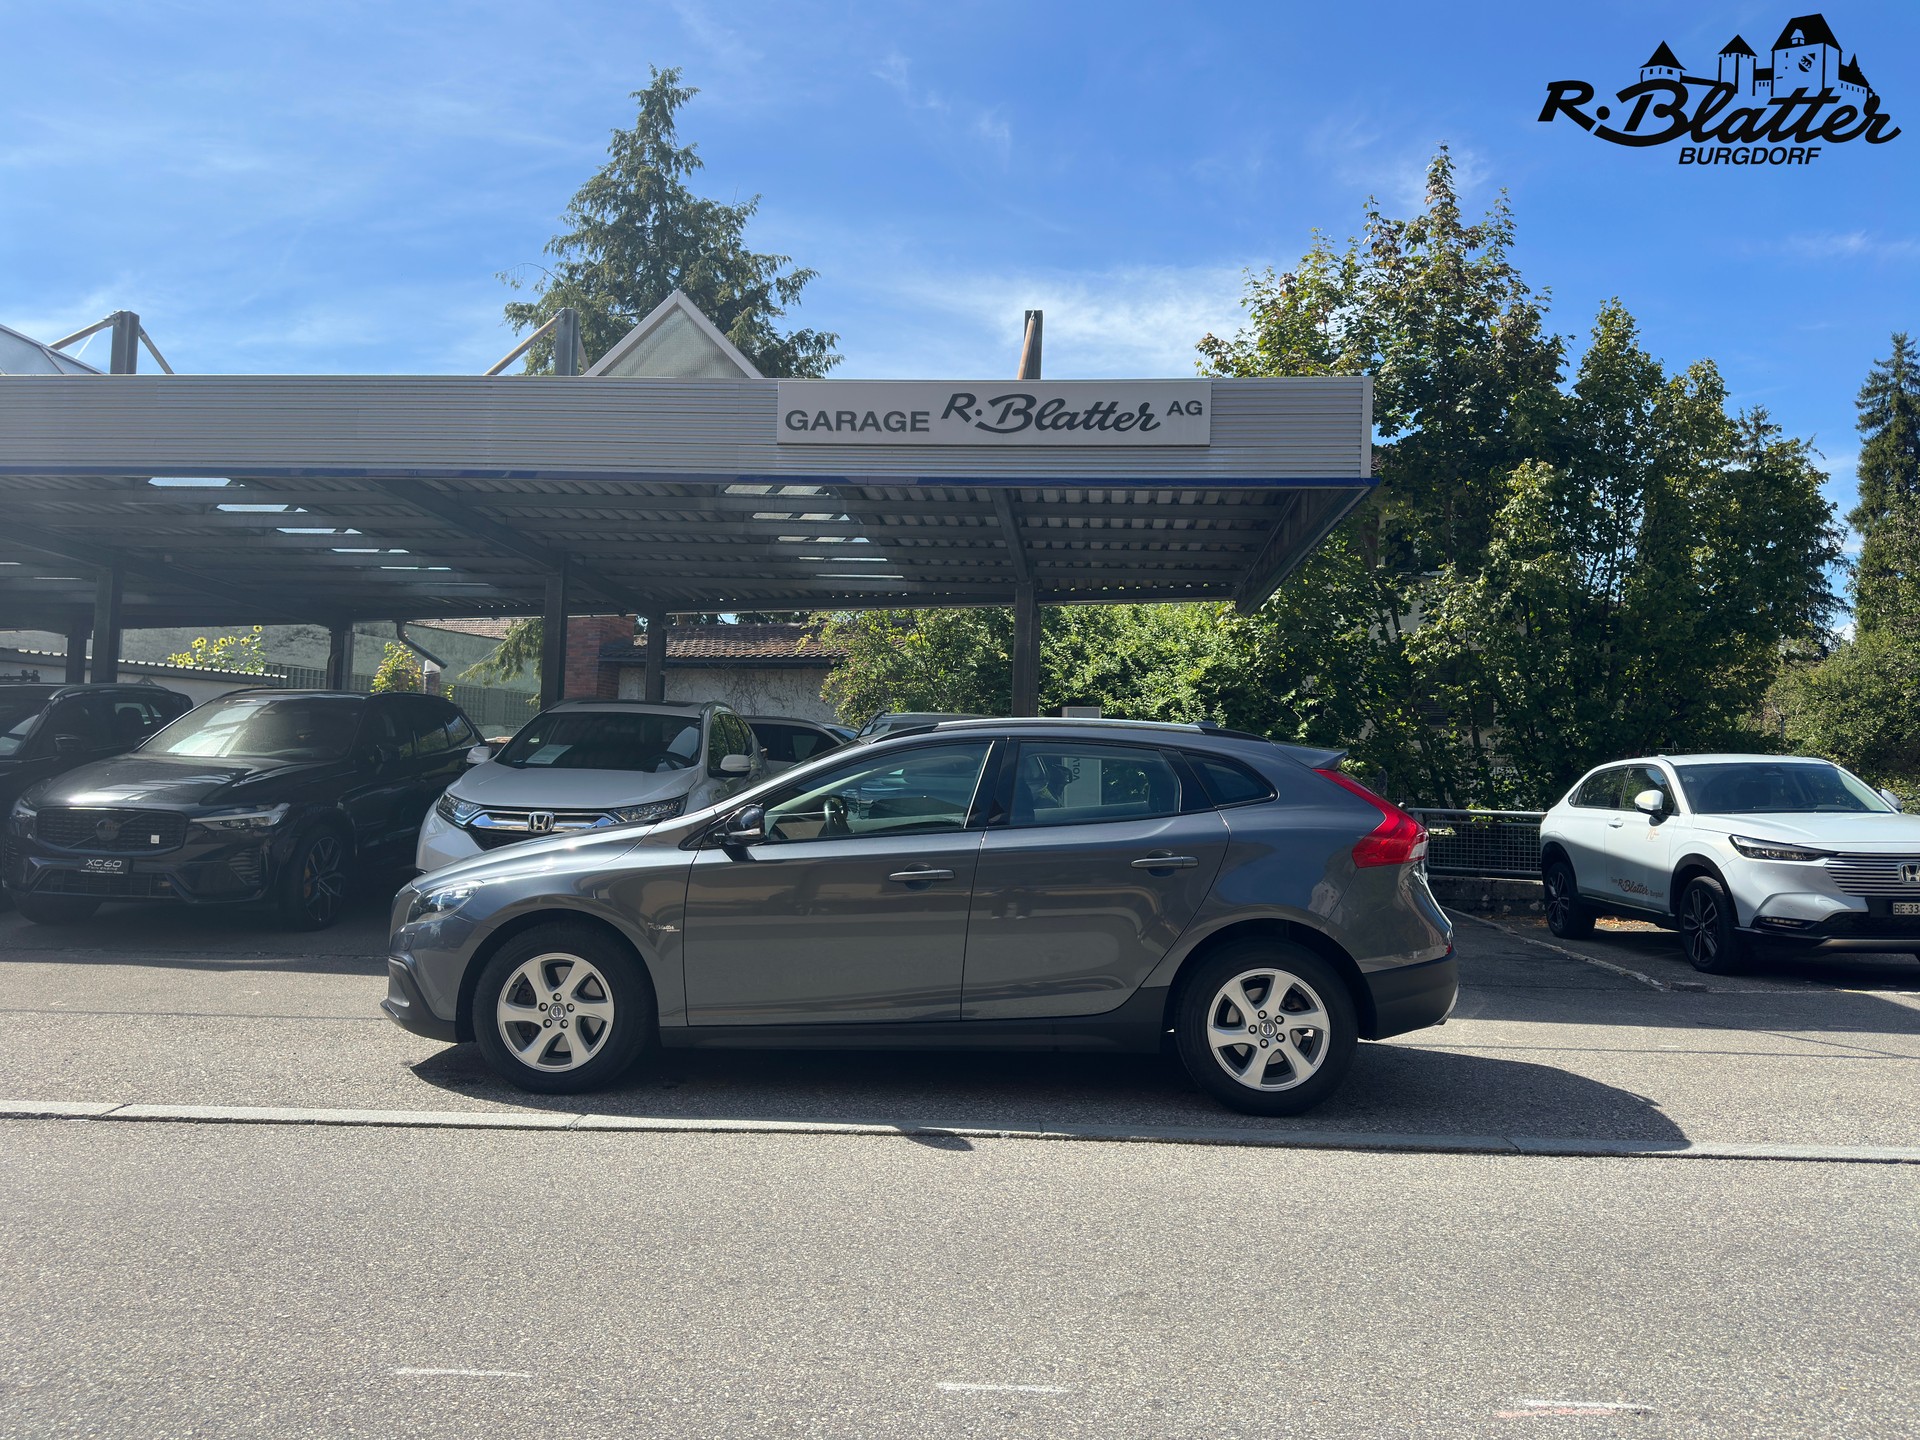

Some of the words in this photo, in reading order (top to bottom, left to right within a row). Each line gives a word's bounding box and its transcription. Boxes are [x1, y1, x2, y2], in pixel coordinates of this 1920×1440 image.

[785, 410, 930, 433] GARAGE
[1166, 400, 1203, 417] AG
[1072, 757, 1081, 781] VOLV
